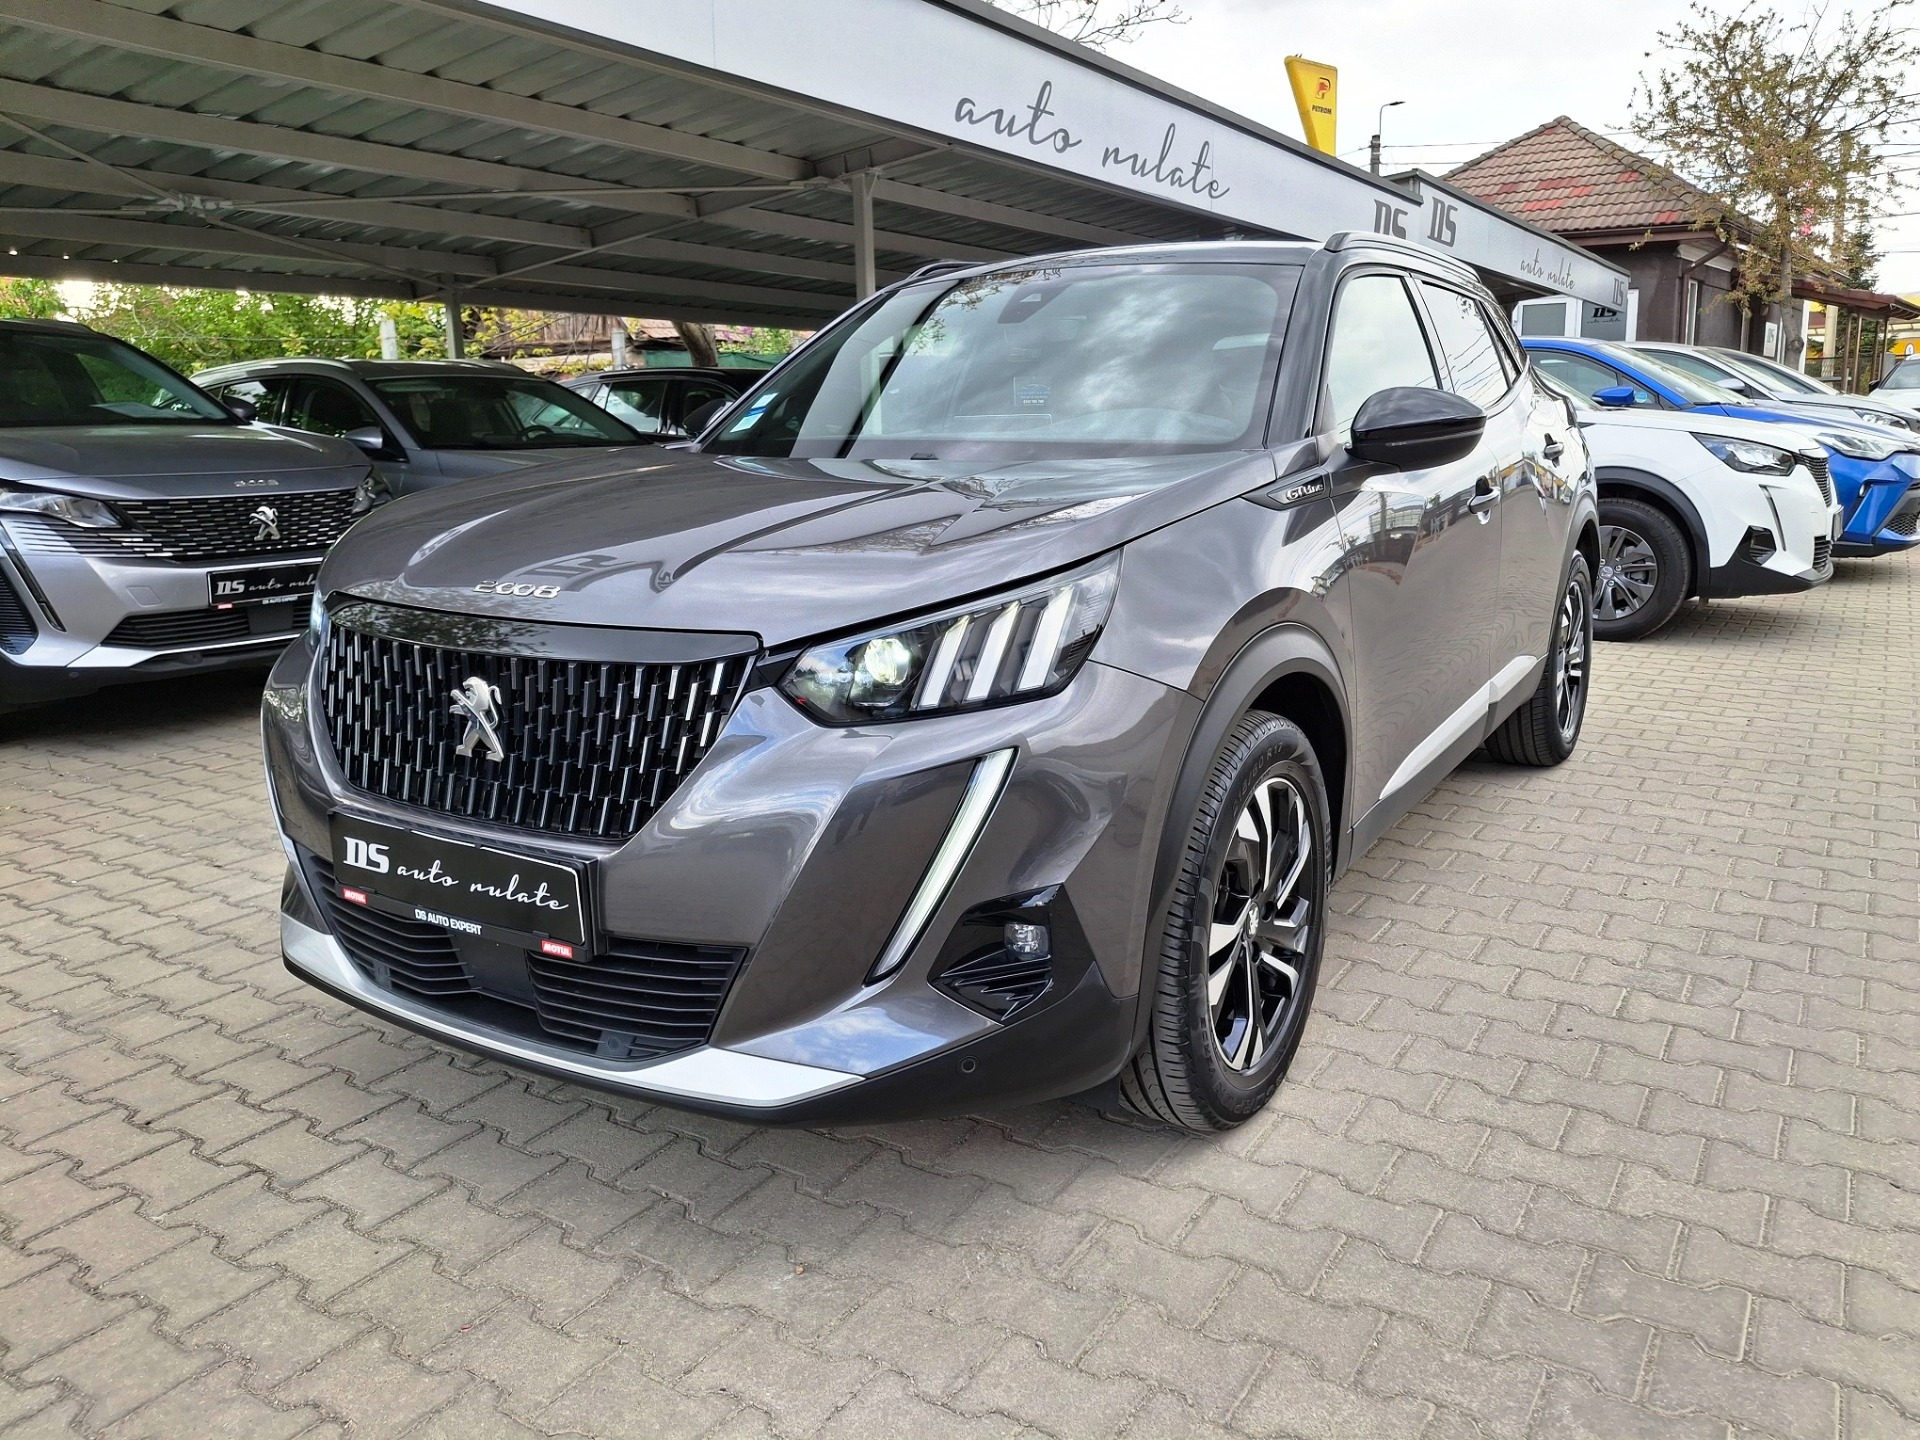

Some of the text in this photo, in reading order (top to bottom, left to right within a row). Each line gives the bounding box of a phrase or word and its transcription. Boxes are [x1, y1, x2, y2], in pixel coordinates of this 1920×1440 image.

[954, 80, 1082, 153] auto
[1311, 104, 1332, 115] PETROM
[1427, 196, 1459, 248] DS
[1520, 248, 1544, 278] auto
[214, 580, 246, 595] DS
[248, 578, 284, 591] auto
[472, 580, 561, 599] 2008
[343, 836, 390, 874] DS
[396, 859, 460, 887] auto
[414, 908, 482, 936] DS AUTO EXPERT
[543, 942, 571, 957] MOTUL
